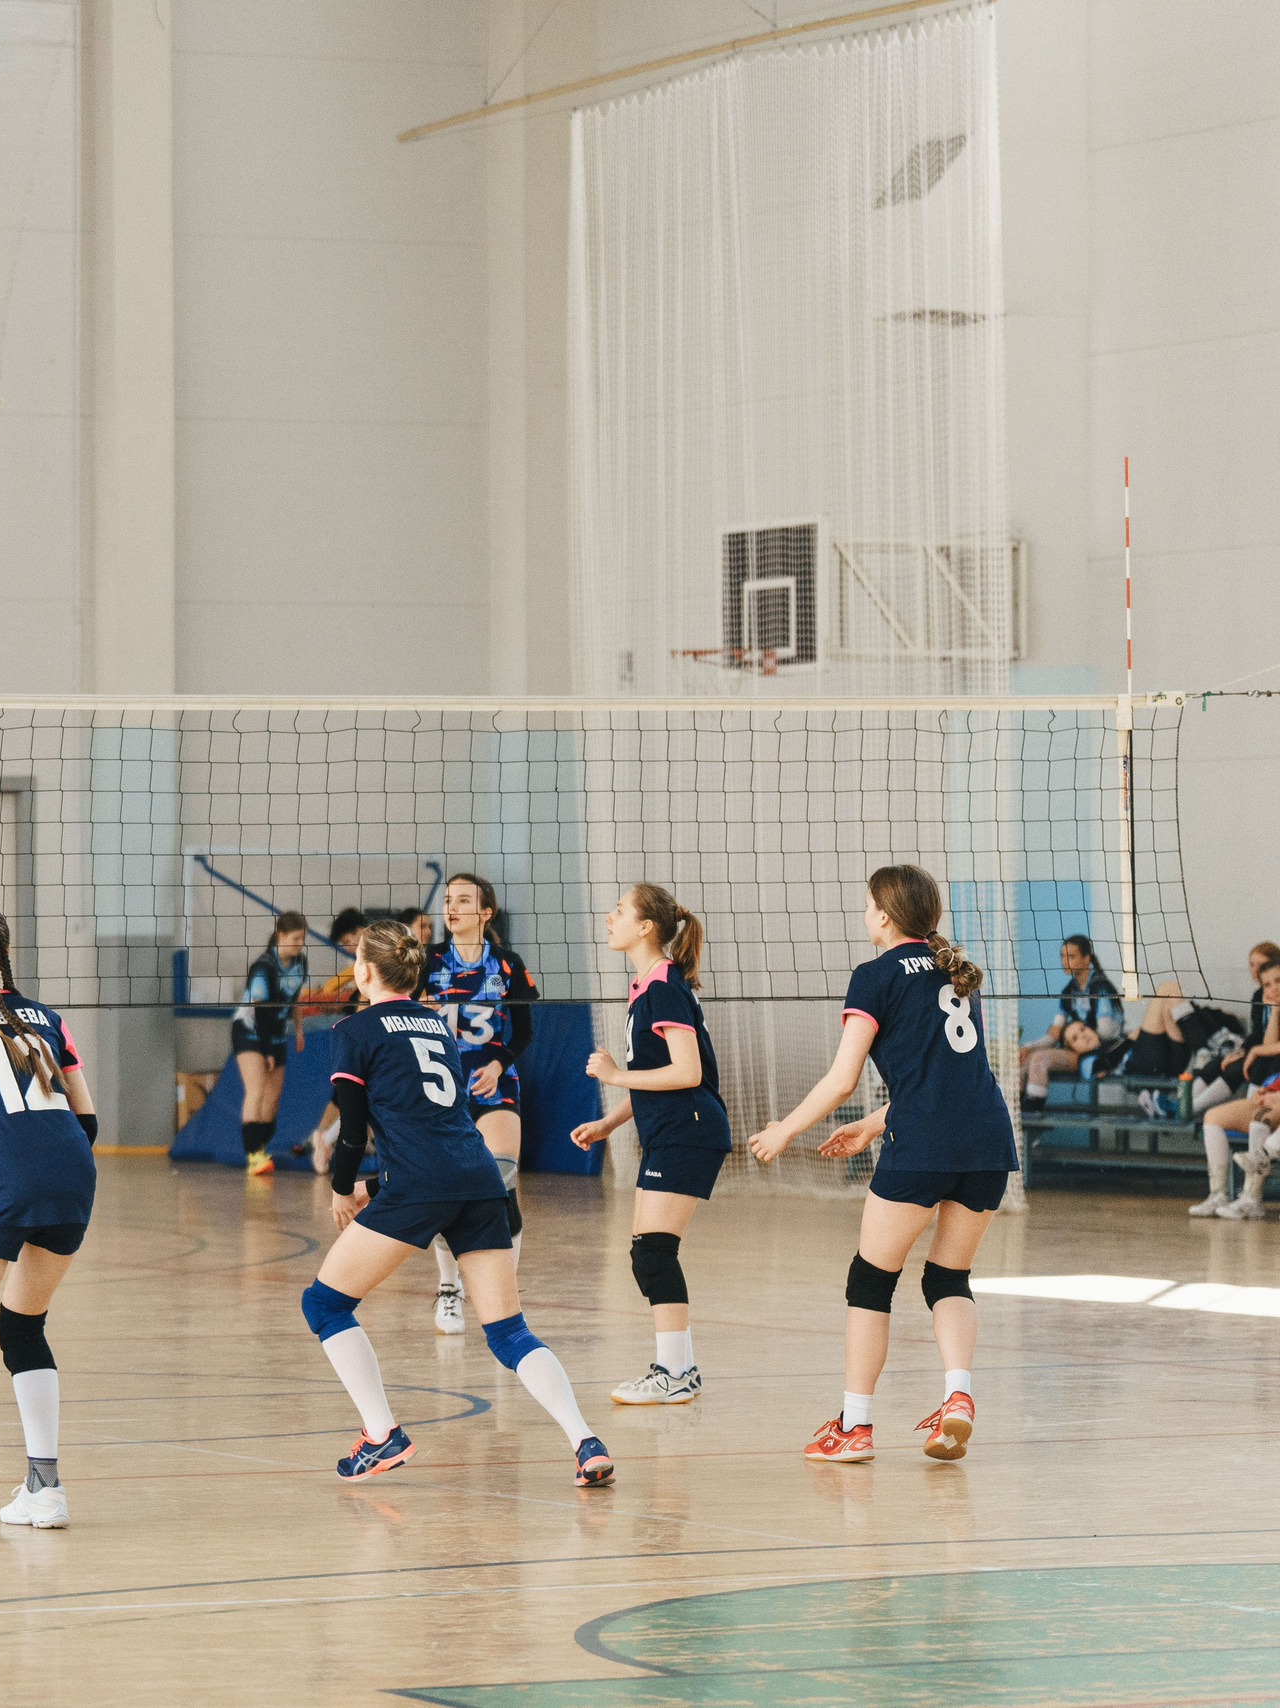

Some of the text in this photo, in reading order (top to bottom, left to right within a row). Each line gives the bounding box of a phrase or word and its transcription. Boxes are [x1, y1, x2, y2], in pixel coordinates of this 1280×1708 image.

[380, 1015, 450, 1037] ИВАНОВА
[437, 1003, 495, 1045] 13
[938, 984, 978, 1054] 8
[408, 1037, 457, 1107] 5
